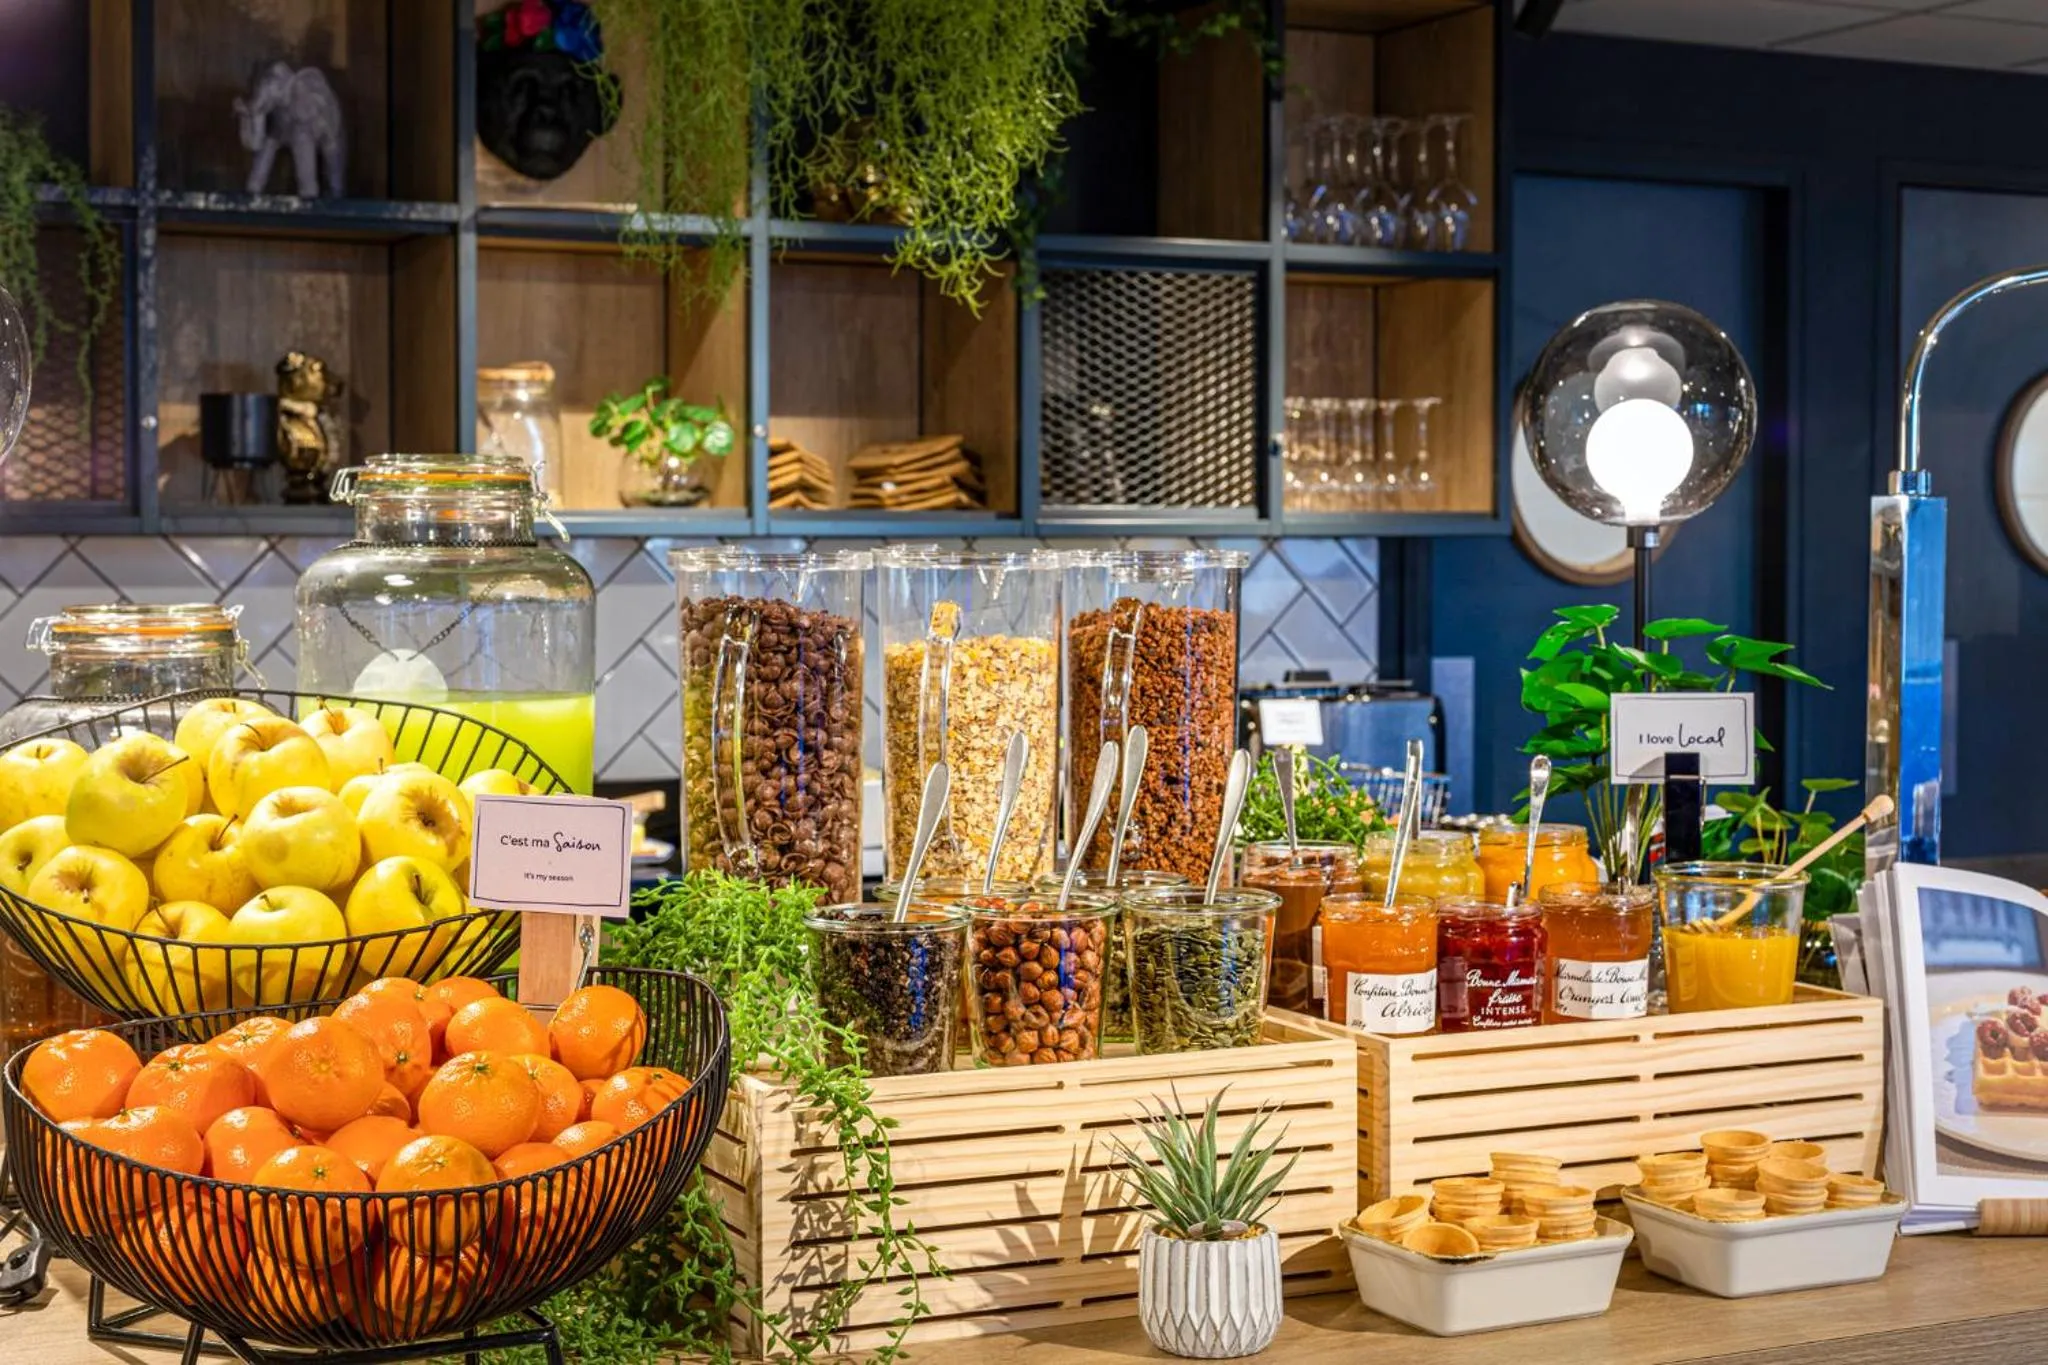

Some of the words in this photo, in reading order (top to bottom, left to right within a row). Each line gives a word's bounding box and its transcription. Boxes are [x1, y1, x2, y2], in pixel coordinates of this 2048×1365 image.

[1646, 733, 1674, 745] love
[500, 834, 528, 848] C'est
[531, 838, 550, 849] ma
[535, 873, 548, 883] my
[548, 874, 574, 882] season
[1465, 968, 1502, 988] Bonne
[1480, 1005, 1528, 1016] INTENSE
